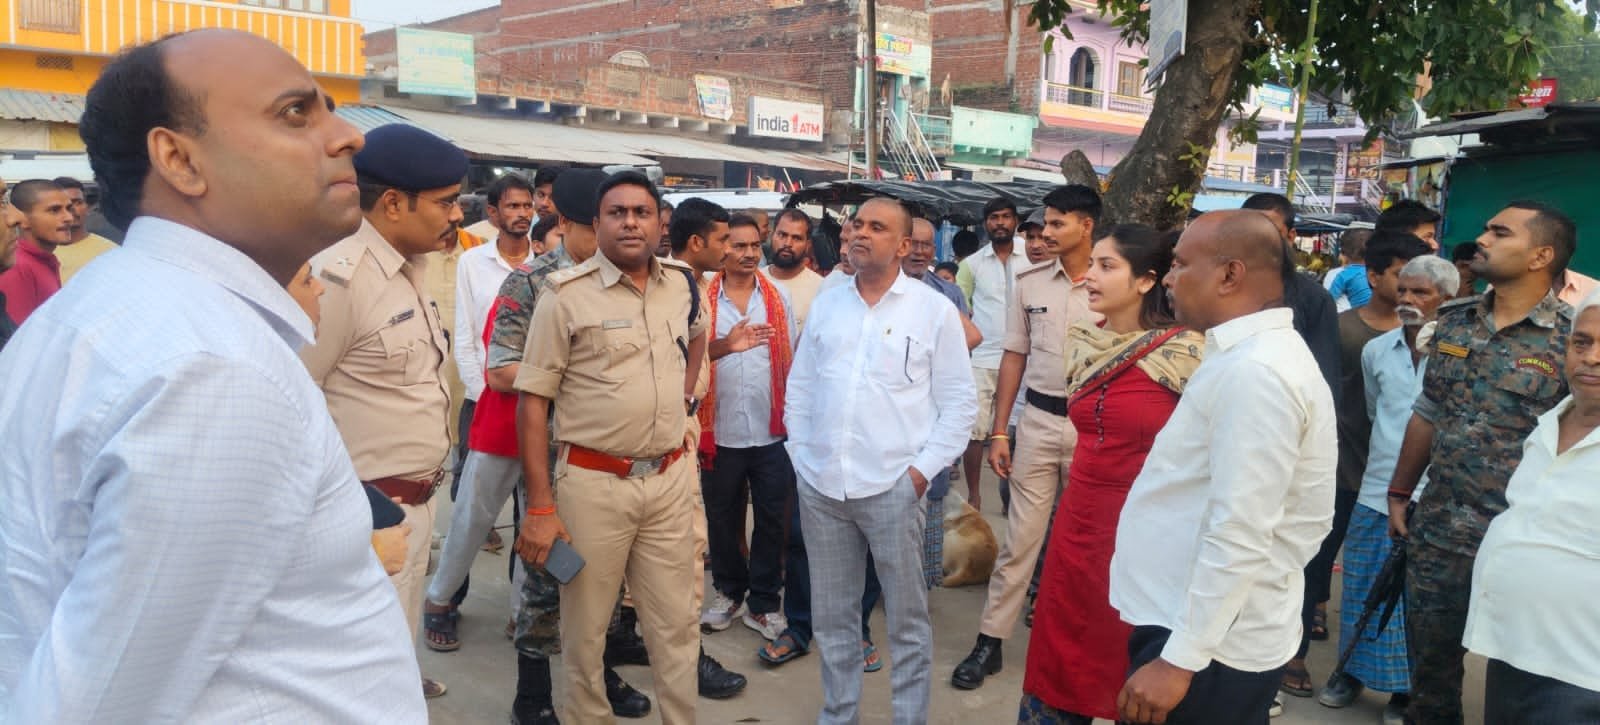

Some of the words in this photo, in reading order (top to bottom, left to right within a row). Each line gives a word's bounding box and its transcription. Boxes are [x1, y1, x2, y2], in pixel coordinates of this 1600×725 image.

[757, 114, 789, 132] india
[800, 123, 820, 136] ATM
[1518, 357, 1554, 374] COMMANDO
